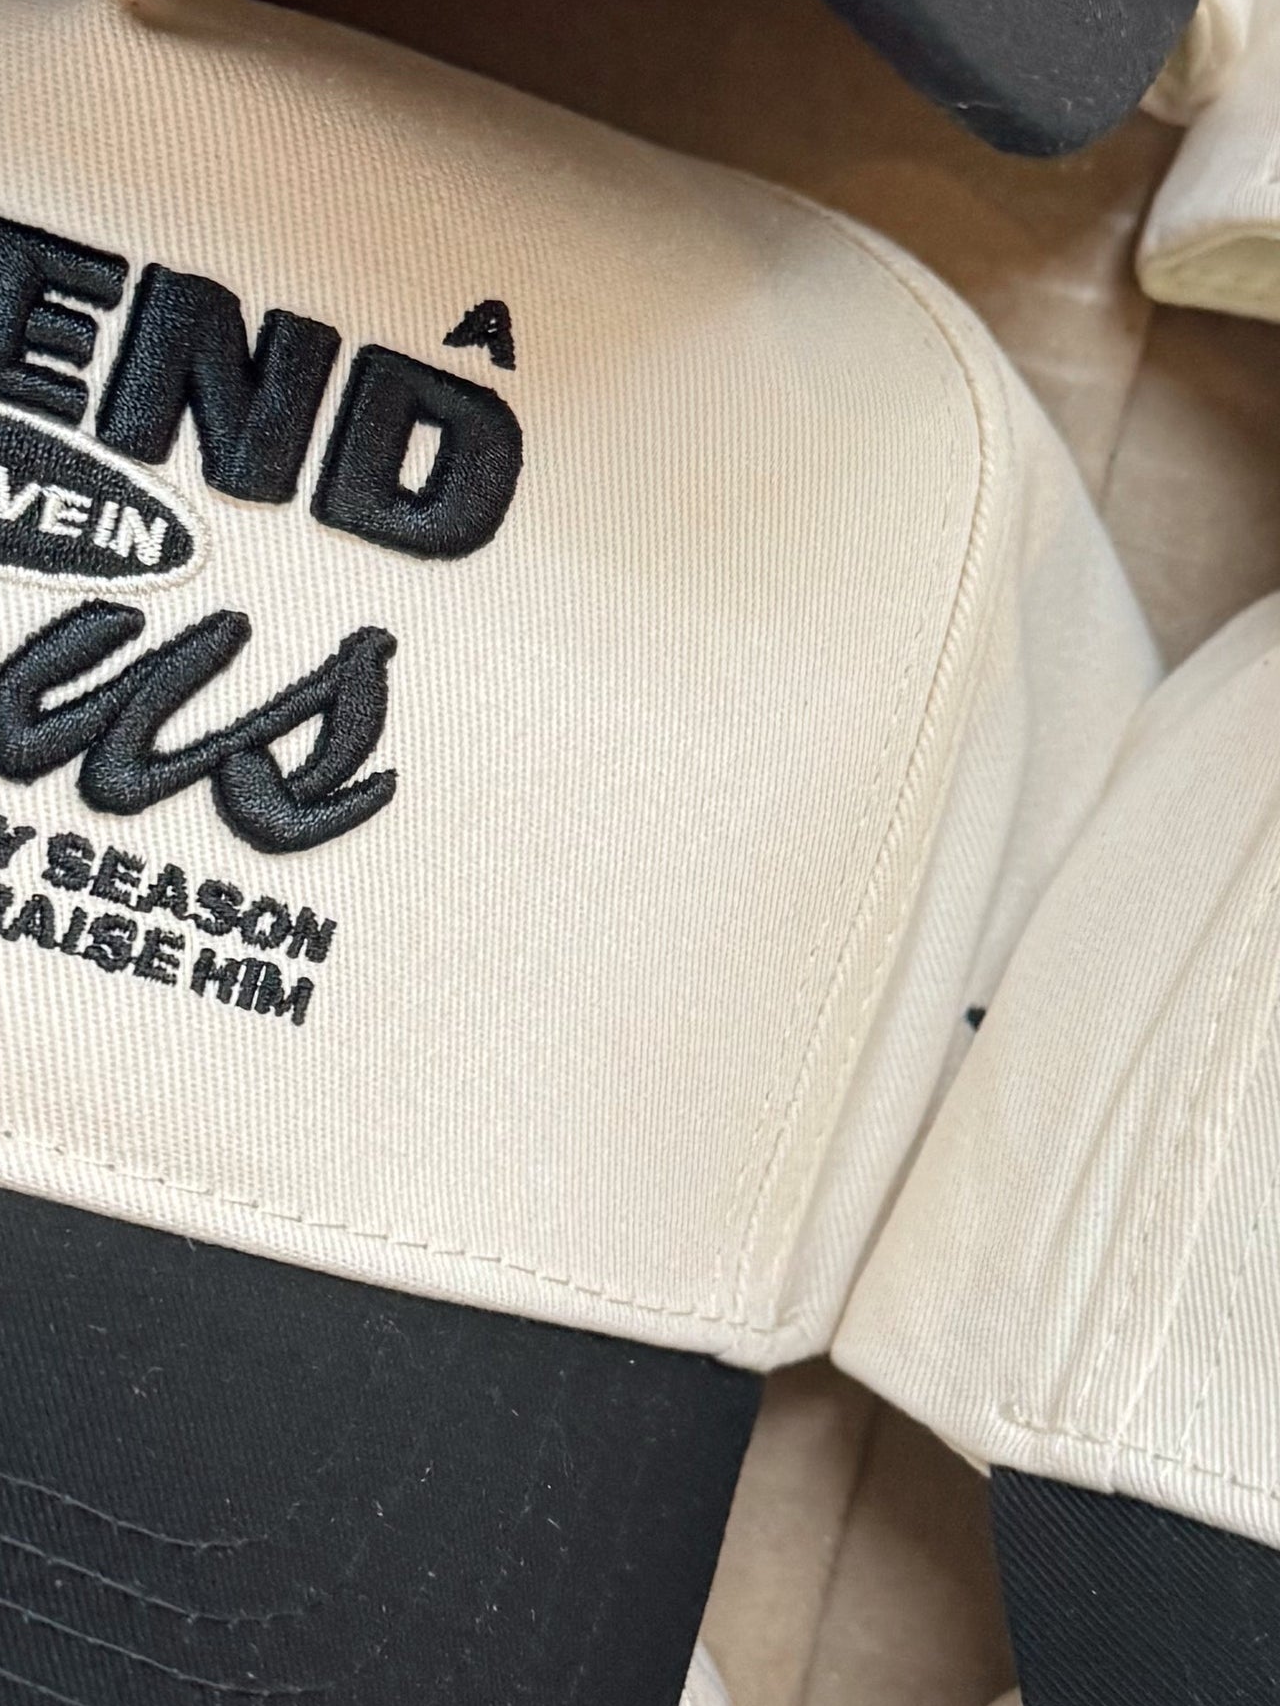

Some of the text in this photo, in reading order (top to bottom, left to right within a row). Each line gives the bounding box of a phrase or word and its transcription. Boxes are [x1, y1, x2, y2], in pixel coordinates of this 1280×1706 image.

[441, 298, 516, 370] A
[39, 831, 340, 964] SEASON
[188, 947, 317, 1026] HIM
